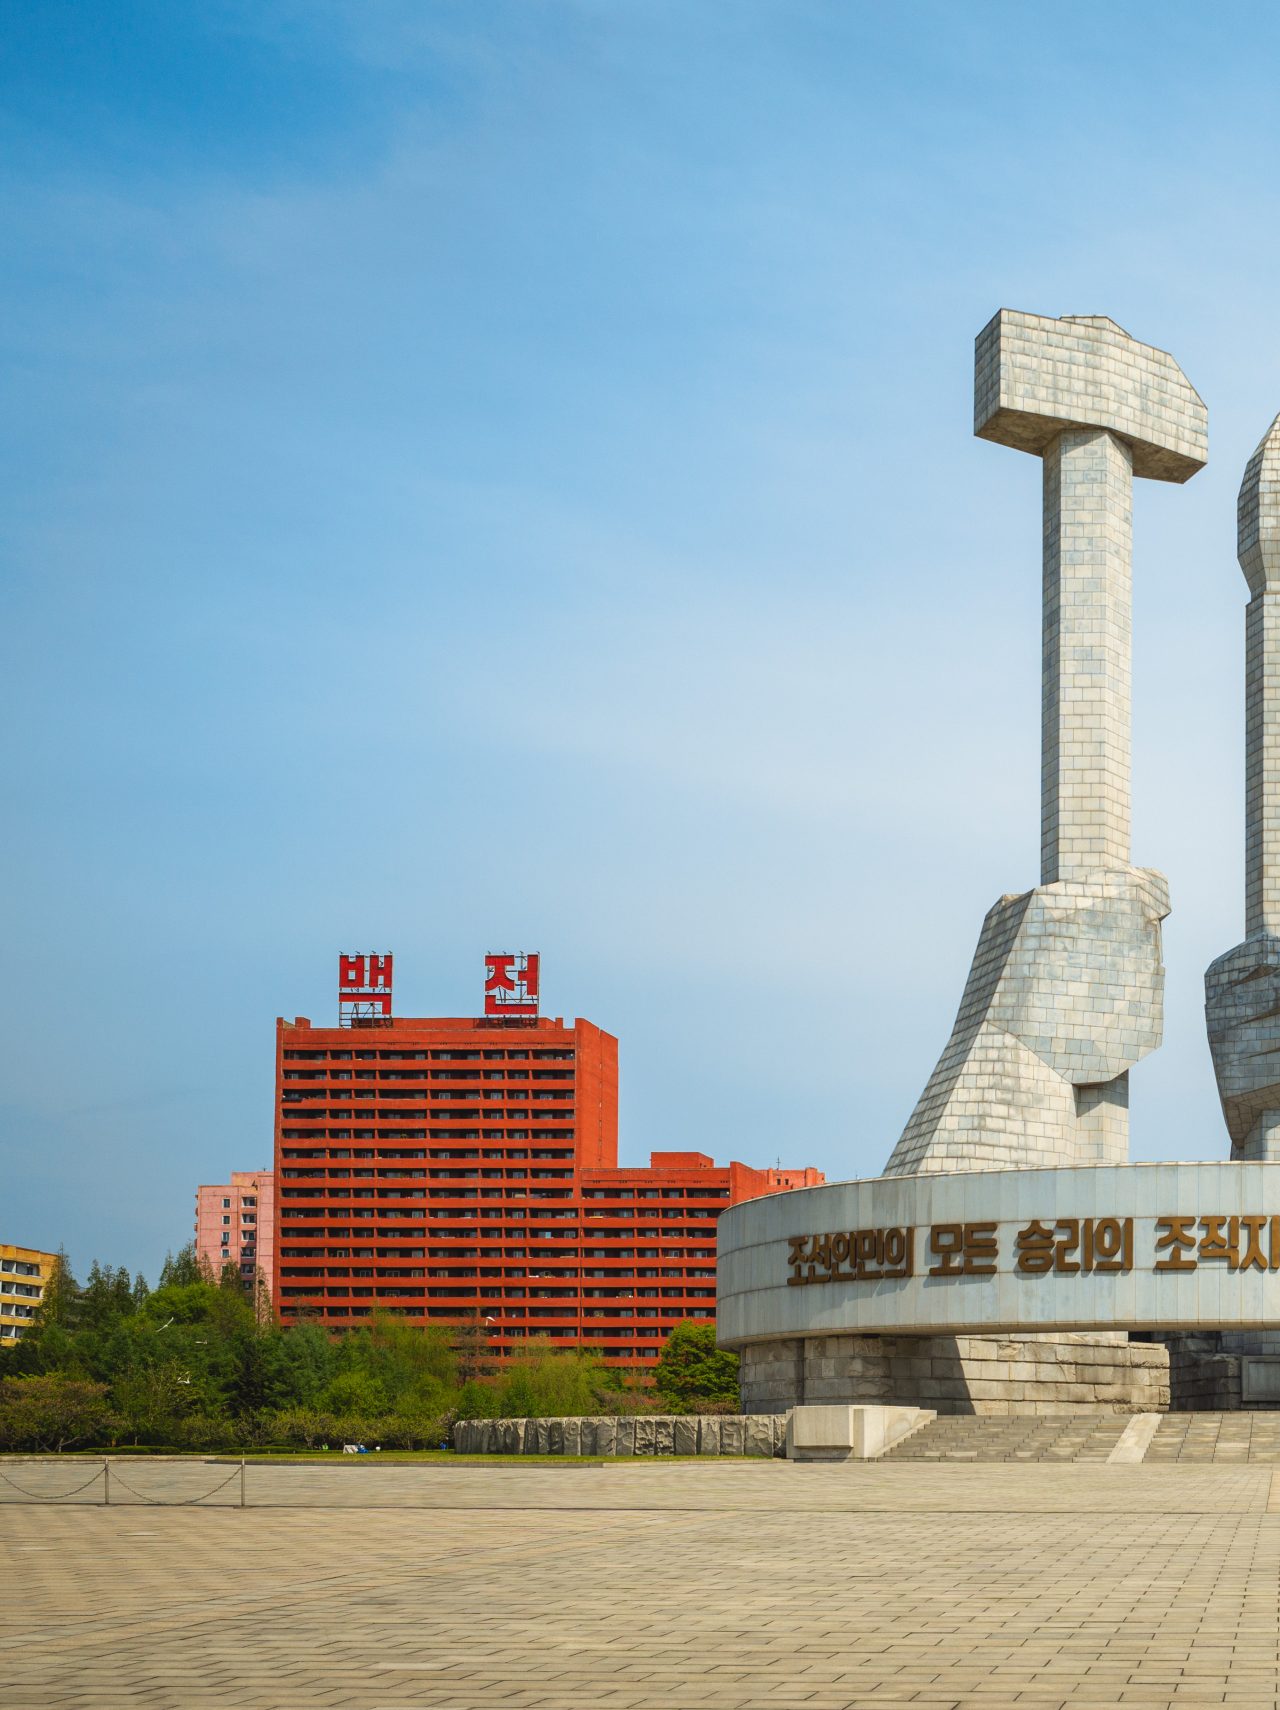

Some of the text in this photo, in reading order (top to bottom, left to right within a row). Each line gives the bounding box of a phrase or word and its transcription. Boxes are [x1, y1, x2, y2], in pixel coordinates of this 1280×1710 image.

[786, 1226, 914, 1287] 조선인민의
[929, 1222, 999, 1275] 모든
[1016, 1217, 1134, 1272] 승리의
